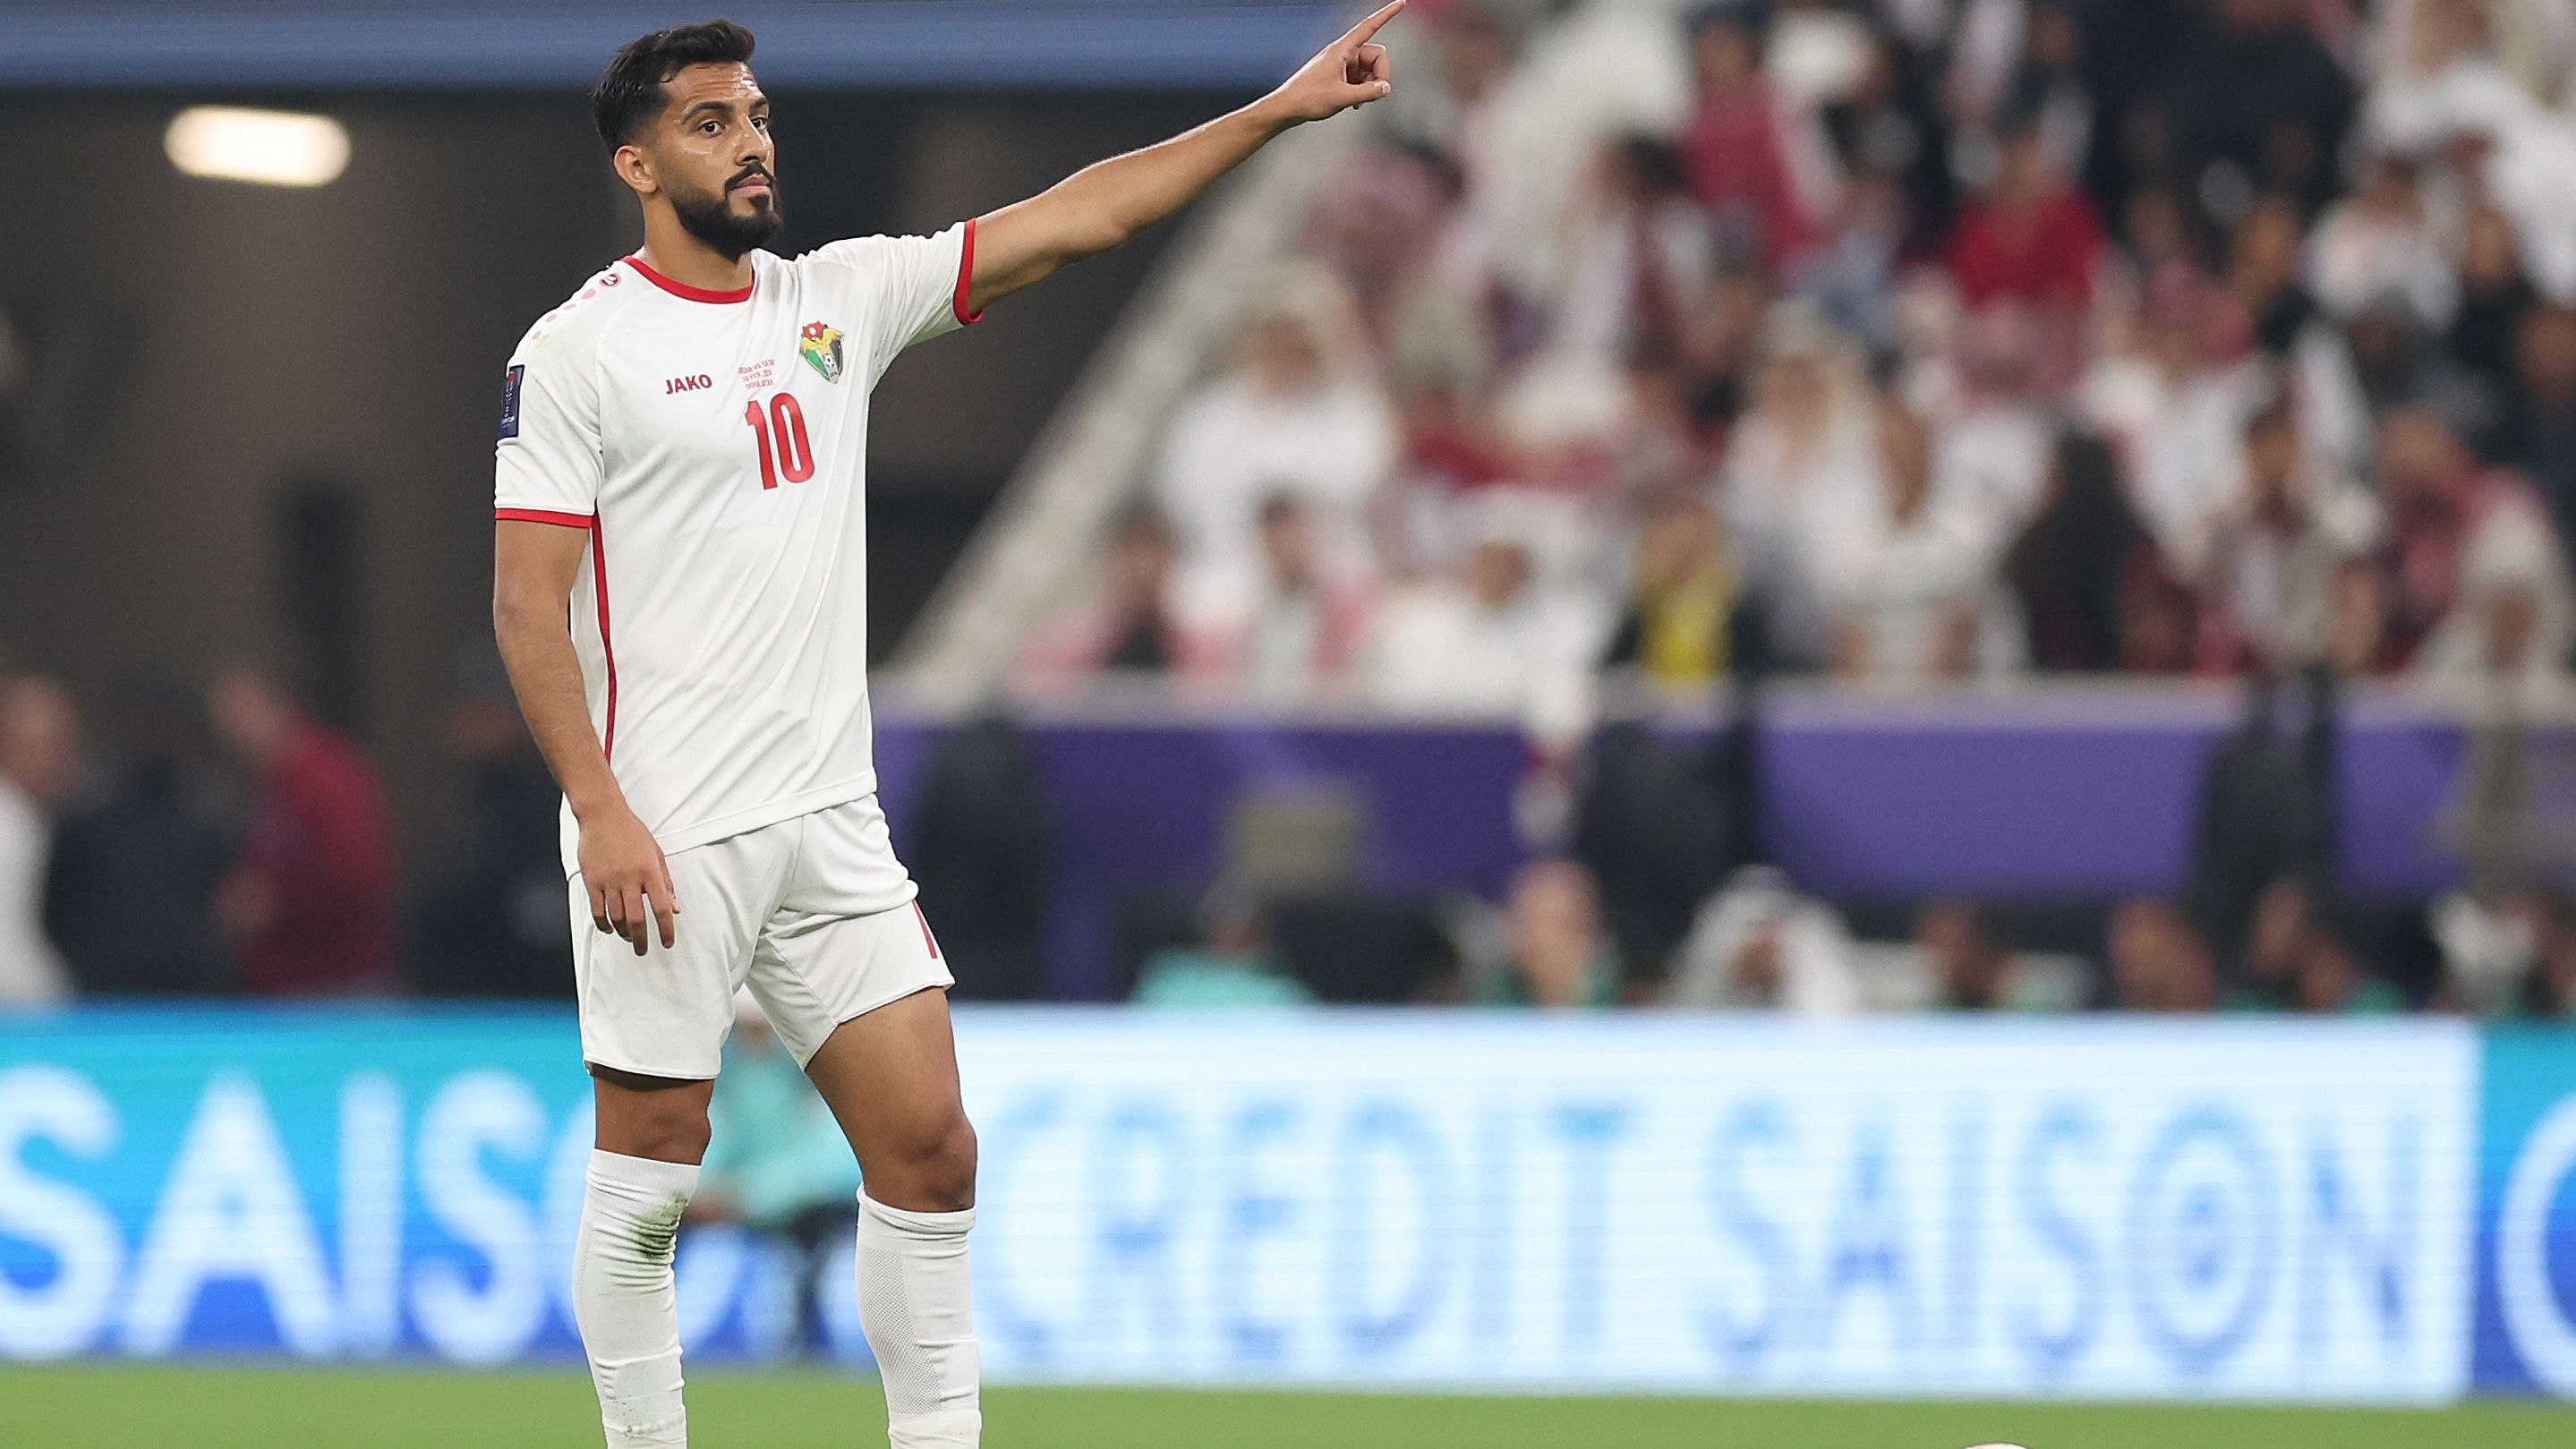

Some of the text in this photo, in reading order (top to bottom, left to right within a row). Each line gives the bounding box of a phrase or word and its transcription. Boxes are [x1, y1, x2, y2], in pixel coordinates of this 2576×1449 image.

[666, 374, 712, 395] JAKO
[745, 392, 815, 490] 10
[0, 1065, 868, 1362] SAIS
[977, 1094, 1645, 1362] CREDIT
[1693, 1097, 2431, 1375] SAISON
